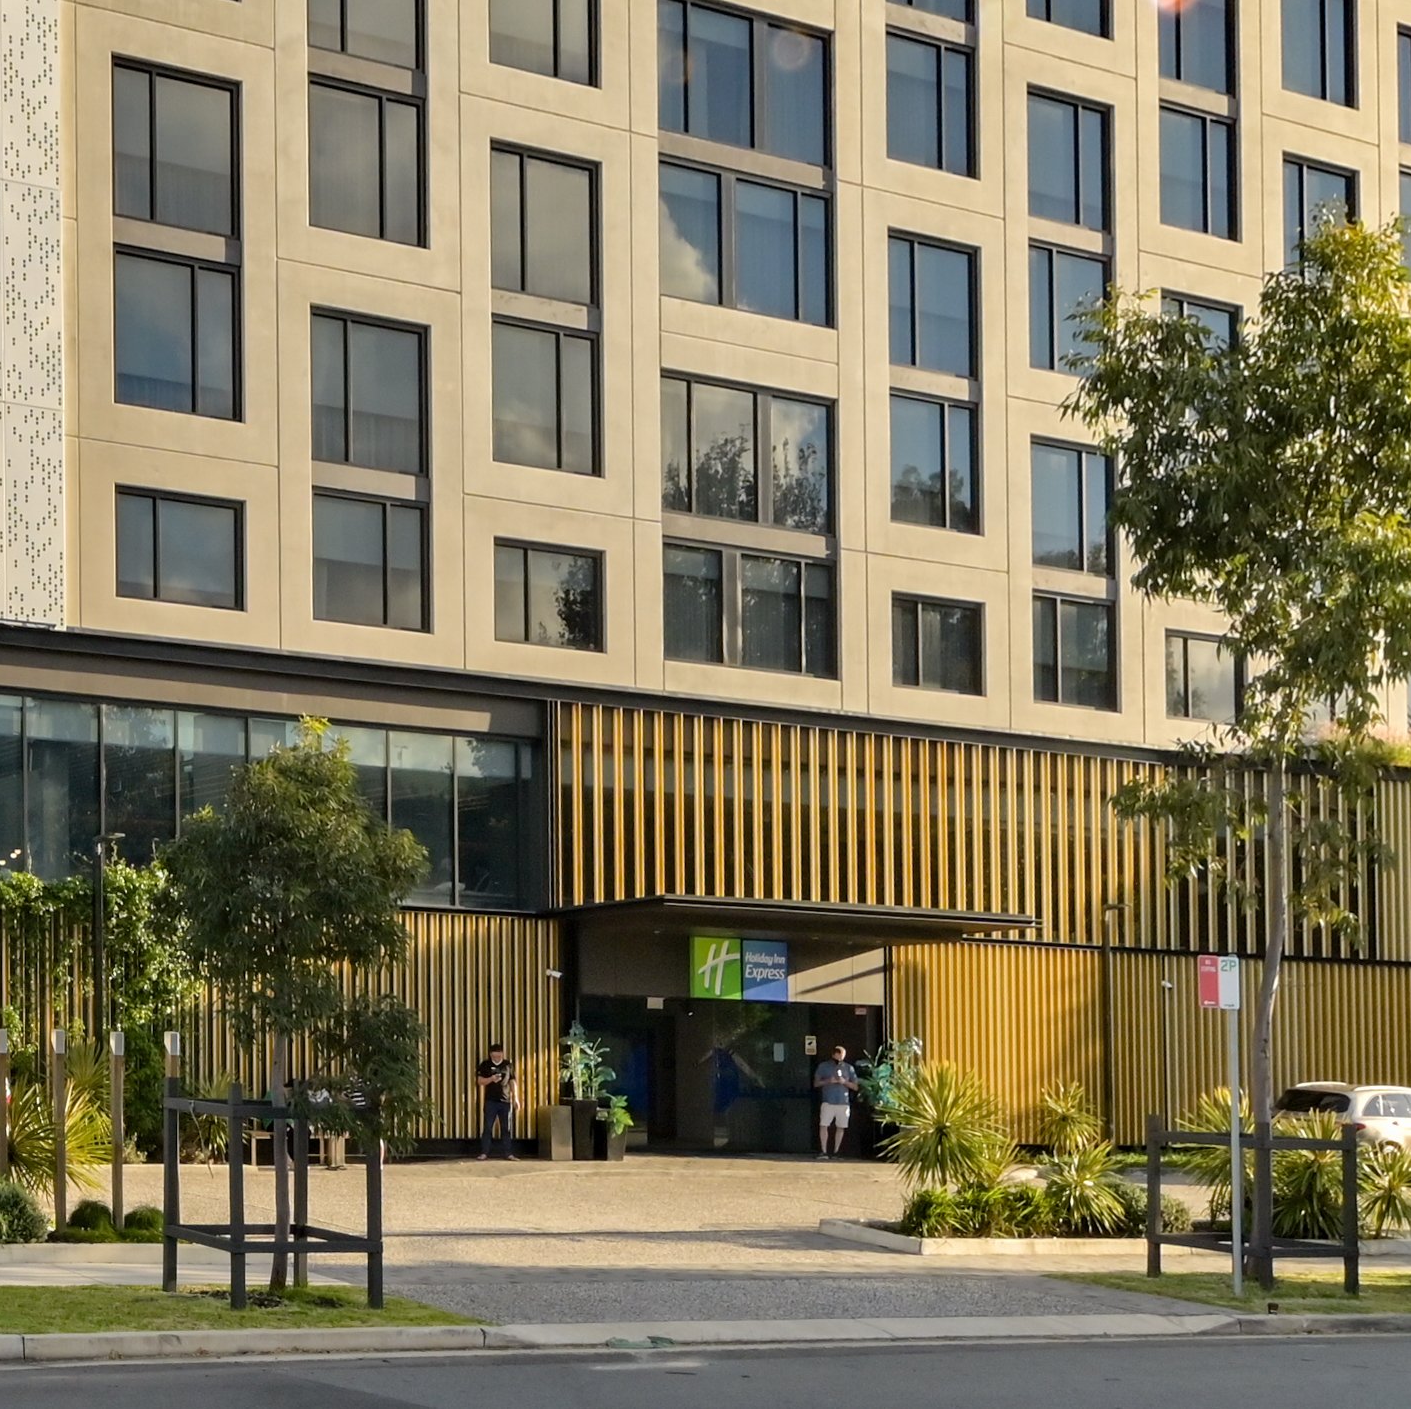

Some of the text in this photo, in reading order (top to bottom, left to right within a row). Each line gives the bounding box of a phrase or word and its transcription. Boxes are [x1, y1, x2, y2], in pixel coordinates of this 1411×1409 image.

[745, 951, 785, 966] Holiday Inn
[1220, 959, 1237, 972] 2P
[745, 964, 785, 982] Express
